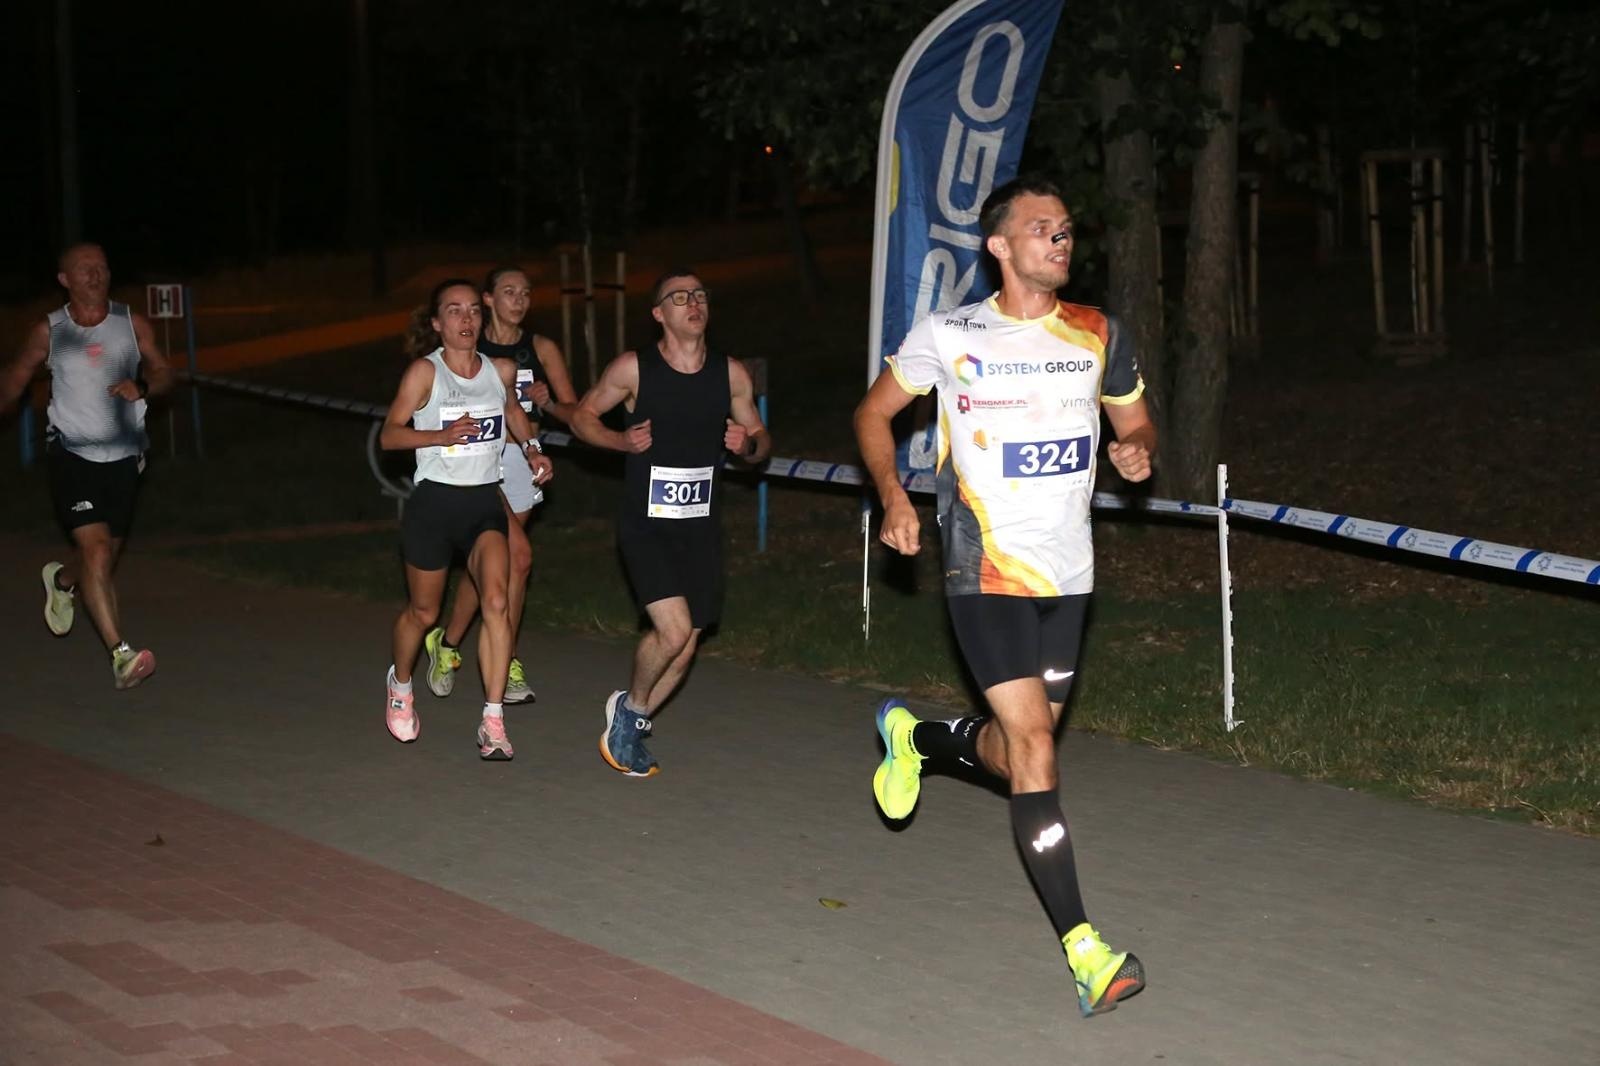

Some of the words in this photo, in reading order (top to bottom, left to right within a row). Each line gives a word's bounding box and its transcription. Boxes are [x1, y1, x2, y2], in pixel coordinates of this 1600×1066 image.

[987, 362, 1041, 375] SYSTEM
[1045, 360, 1093, 374] GROUP
[1018, 440, 1080, 475] 324
[662, 482, 702, 504] 301
